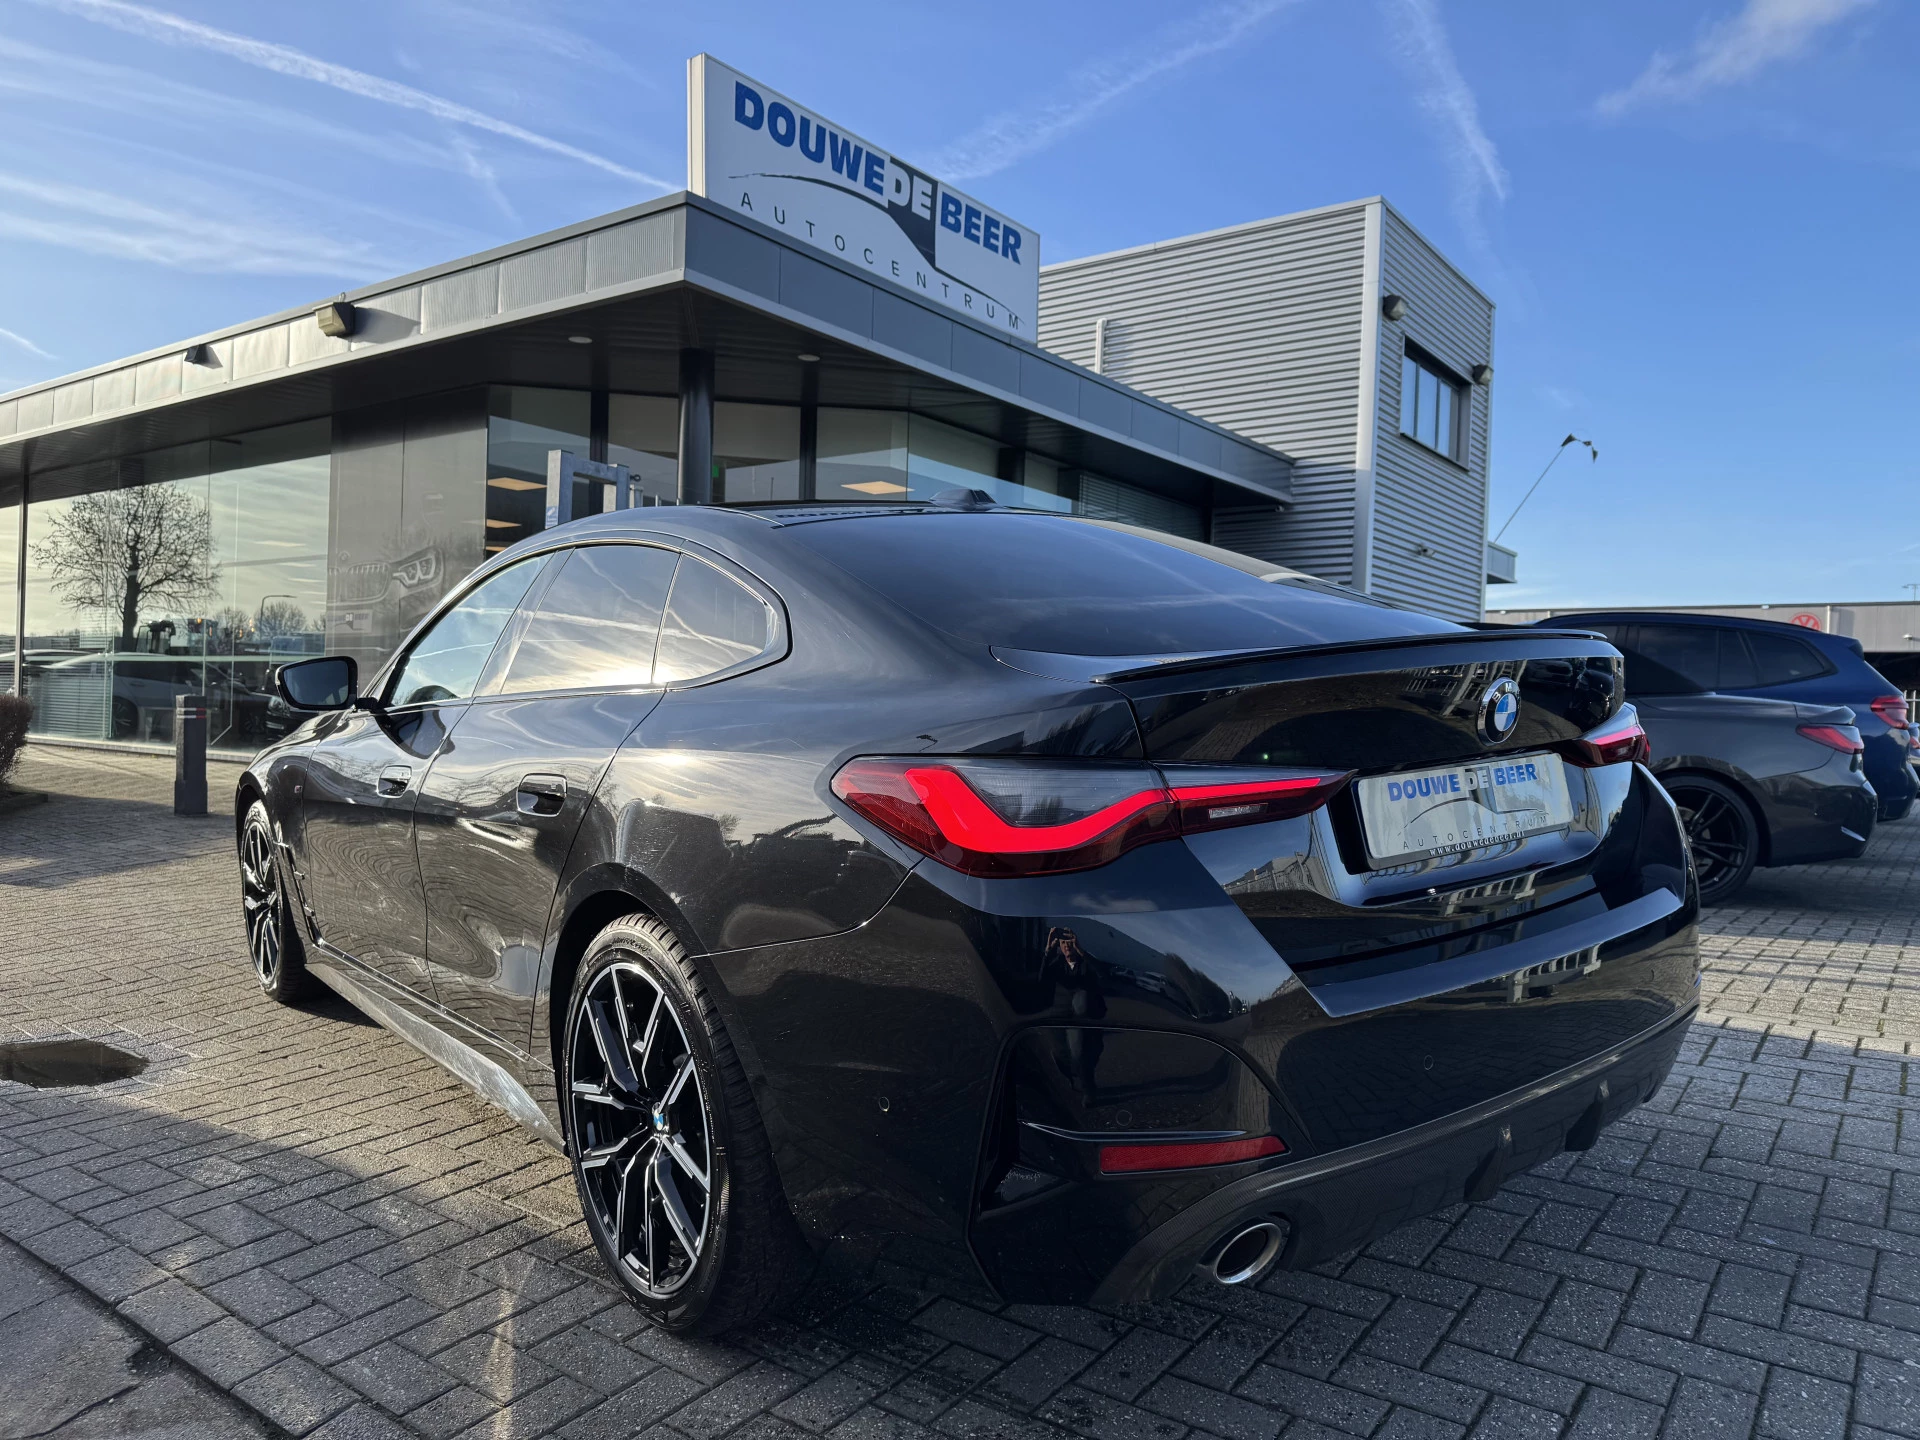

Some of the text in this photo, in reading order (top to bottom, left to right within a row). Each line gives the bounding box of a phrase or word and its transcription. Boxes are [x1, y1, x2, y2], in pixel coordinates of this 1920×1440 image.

[735, 80, 1022, 265] DOUWE DE BEER
[740, 192, 1019, 330] AUTOCENTRUM
[1388, 763, 1537, 801] DOUWE DE BEER
[1403, 814, 1547, 850] AUTOCENTRUM
